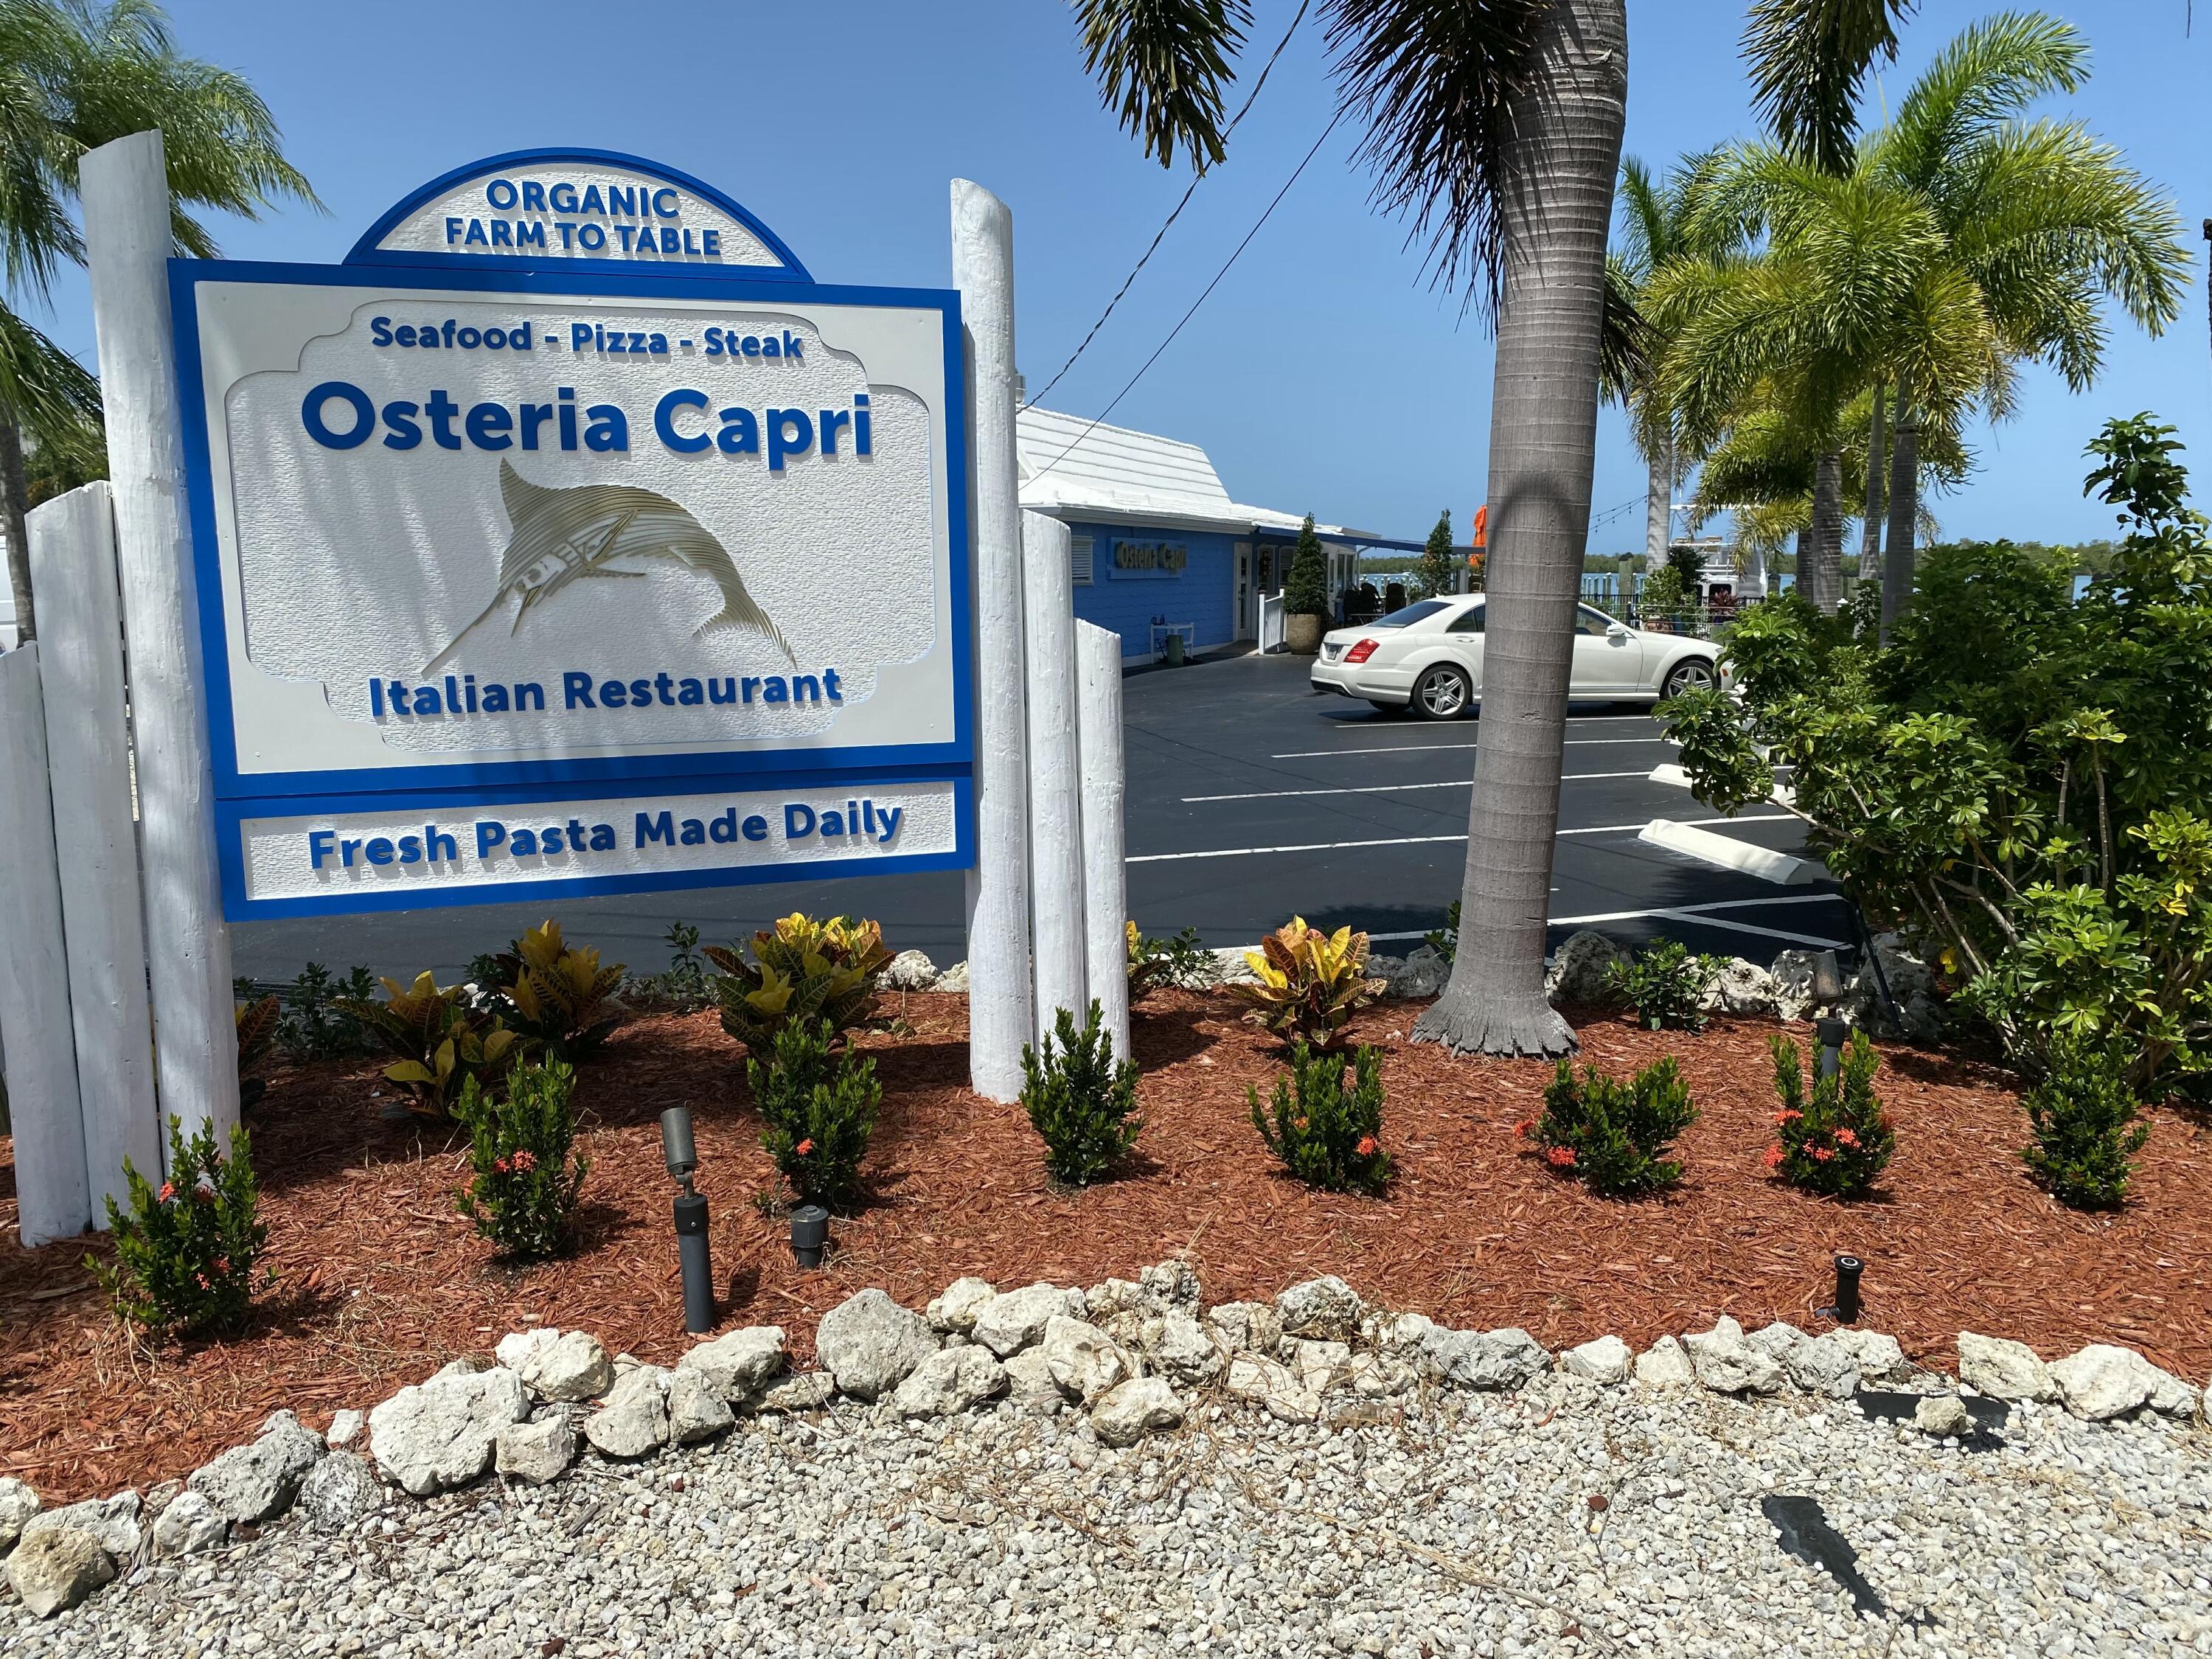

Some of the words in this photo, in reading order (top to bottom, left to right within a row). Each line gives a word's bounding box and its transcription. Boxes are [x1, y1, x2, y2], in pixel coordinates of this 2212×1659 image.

[487, 179, 679, 219] ORGANIC
[445, 217, 546, 248] FARM
[554, 222, 606, 251] TO
[613, 225, 720, 256] TABLE
[371, 316, 532, 351] Seafood
[571, 323, 668, 355] Pizza
[704, 327, 803, 358] Steak
[301, 381, 629, 451] Osteria
[654, 389, 871, 471] Capri
[1116, 542, 1158, 568] Osteria
[369, 675, 545, 717] Italian
[563, 668, 842, 709] Restaurant
[309, 825, 457, 869] Fresh
[476, 819, 615, 859] Pasta
[635, 807, 768, 848] Made
[784, 799, 902, 843] Daily
